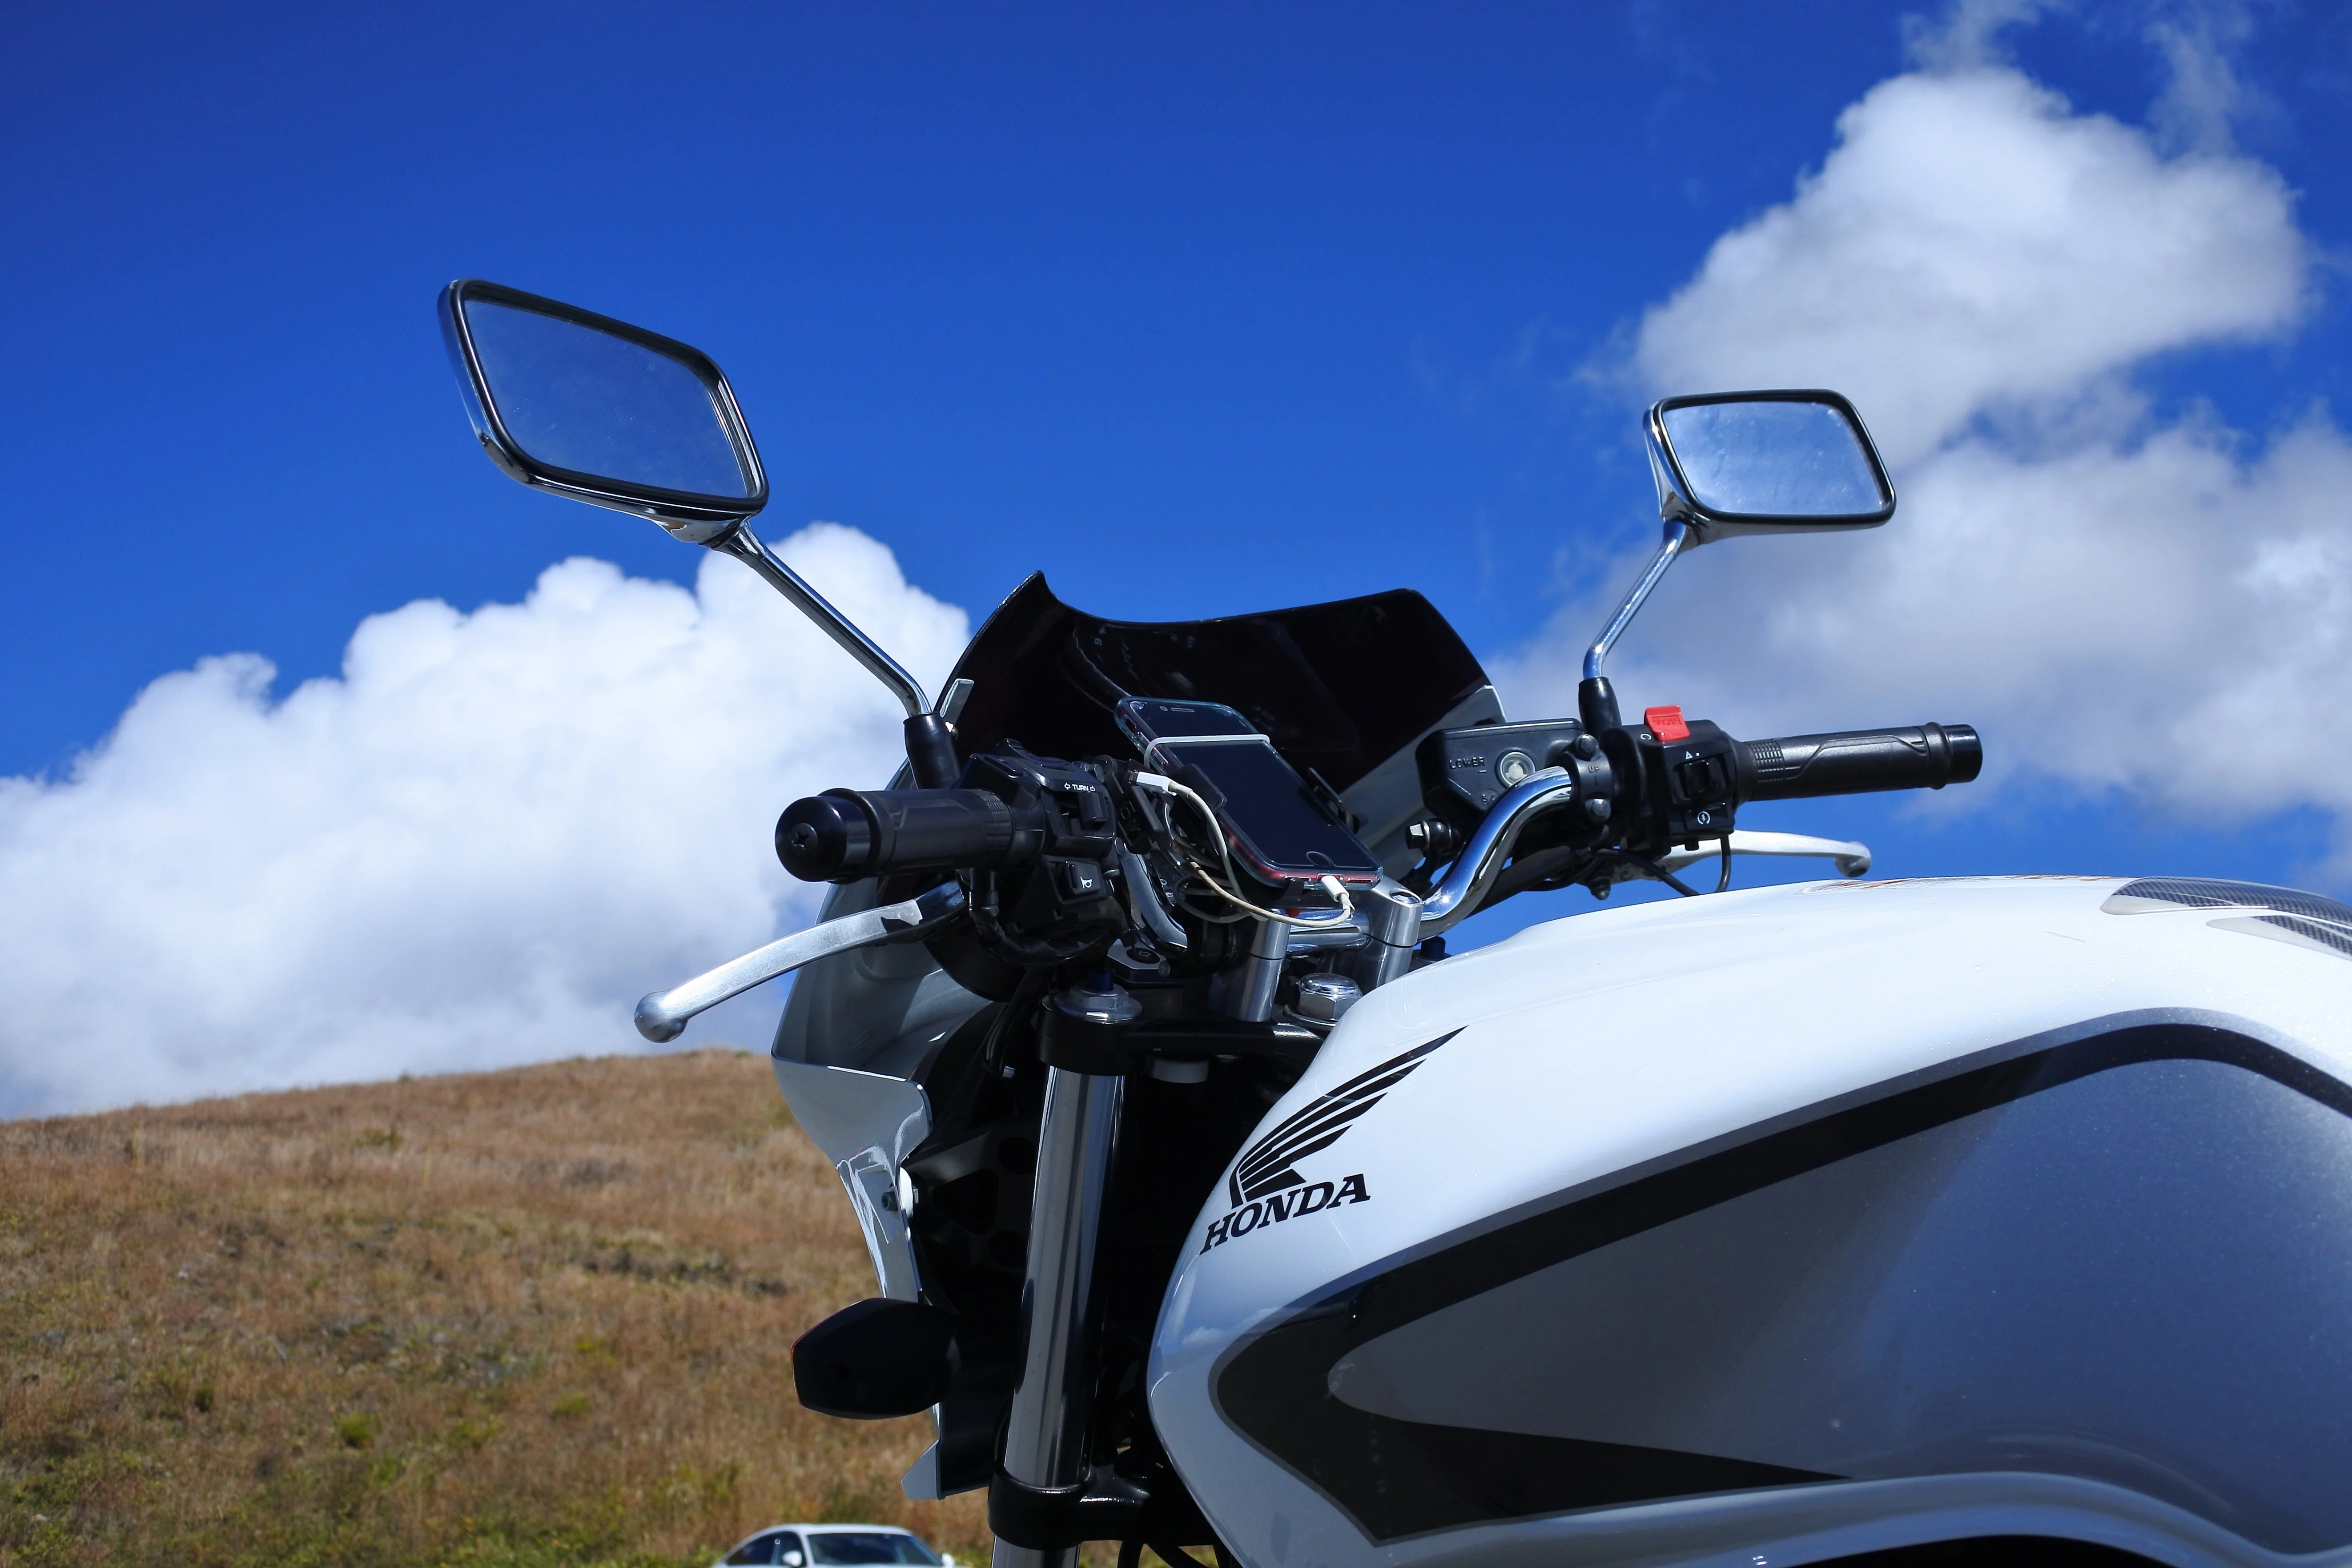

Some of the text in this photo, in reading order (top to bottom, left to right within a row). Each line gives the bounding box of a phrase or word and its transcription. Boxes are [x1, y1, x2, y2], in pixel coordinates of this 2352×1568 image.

[1449, 756, 1485, 768] LOWER
[1588, 765, 1600, 773] UP
[1199, 1173, 1371, 1255] HONDA
